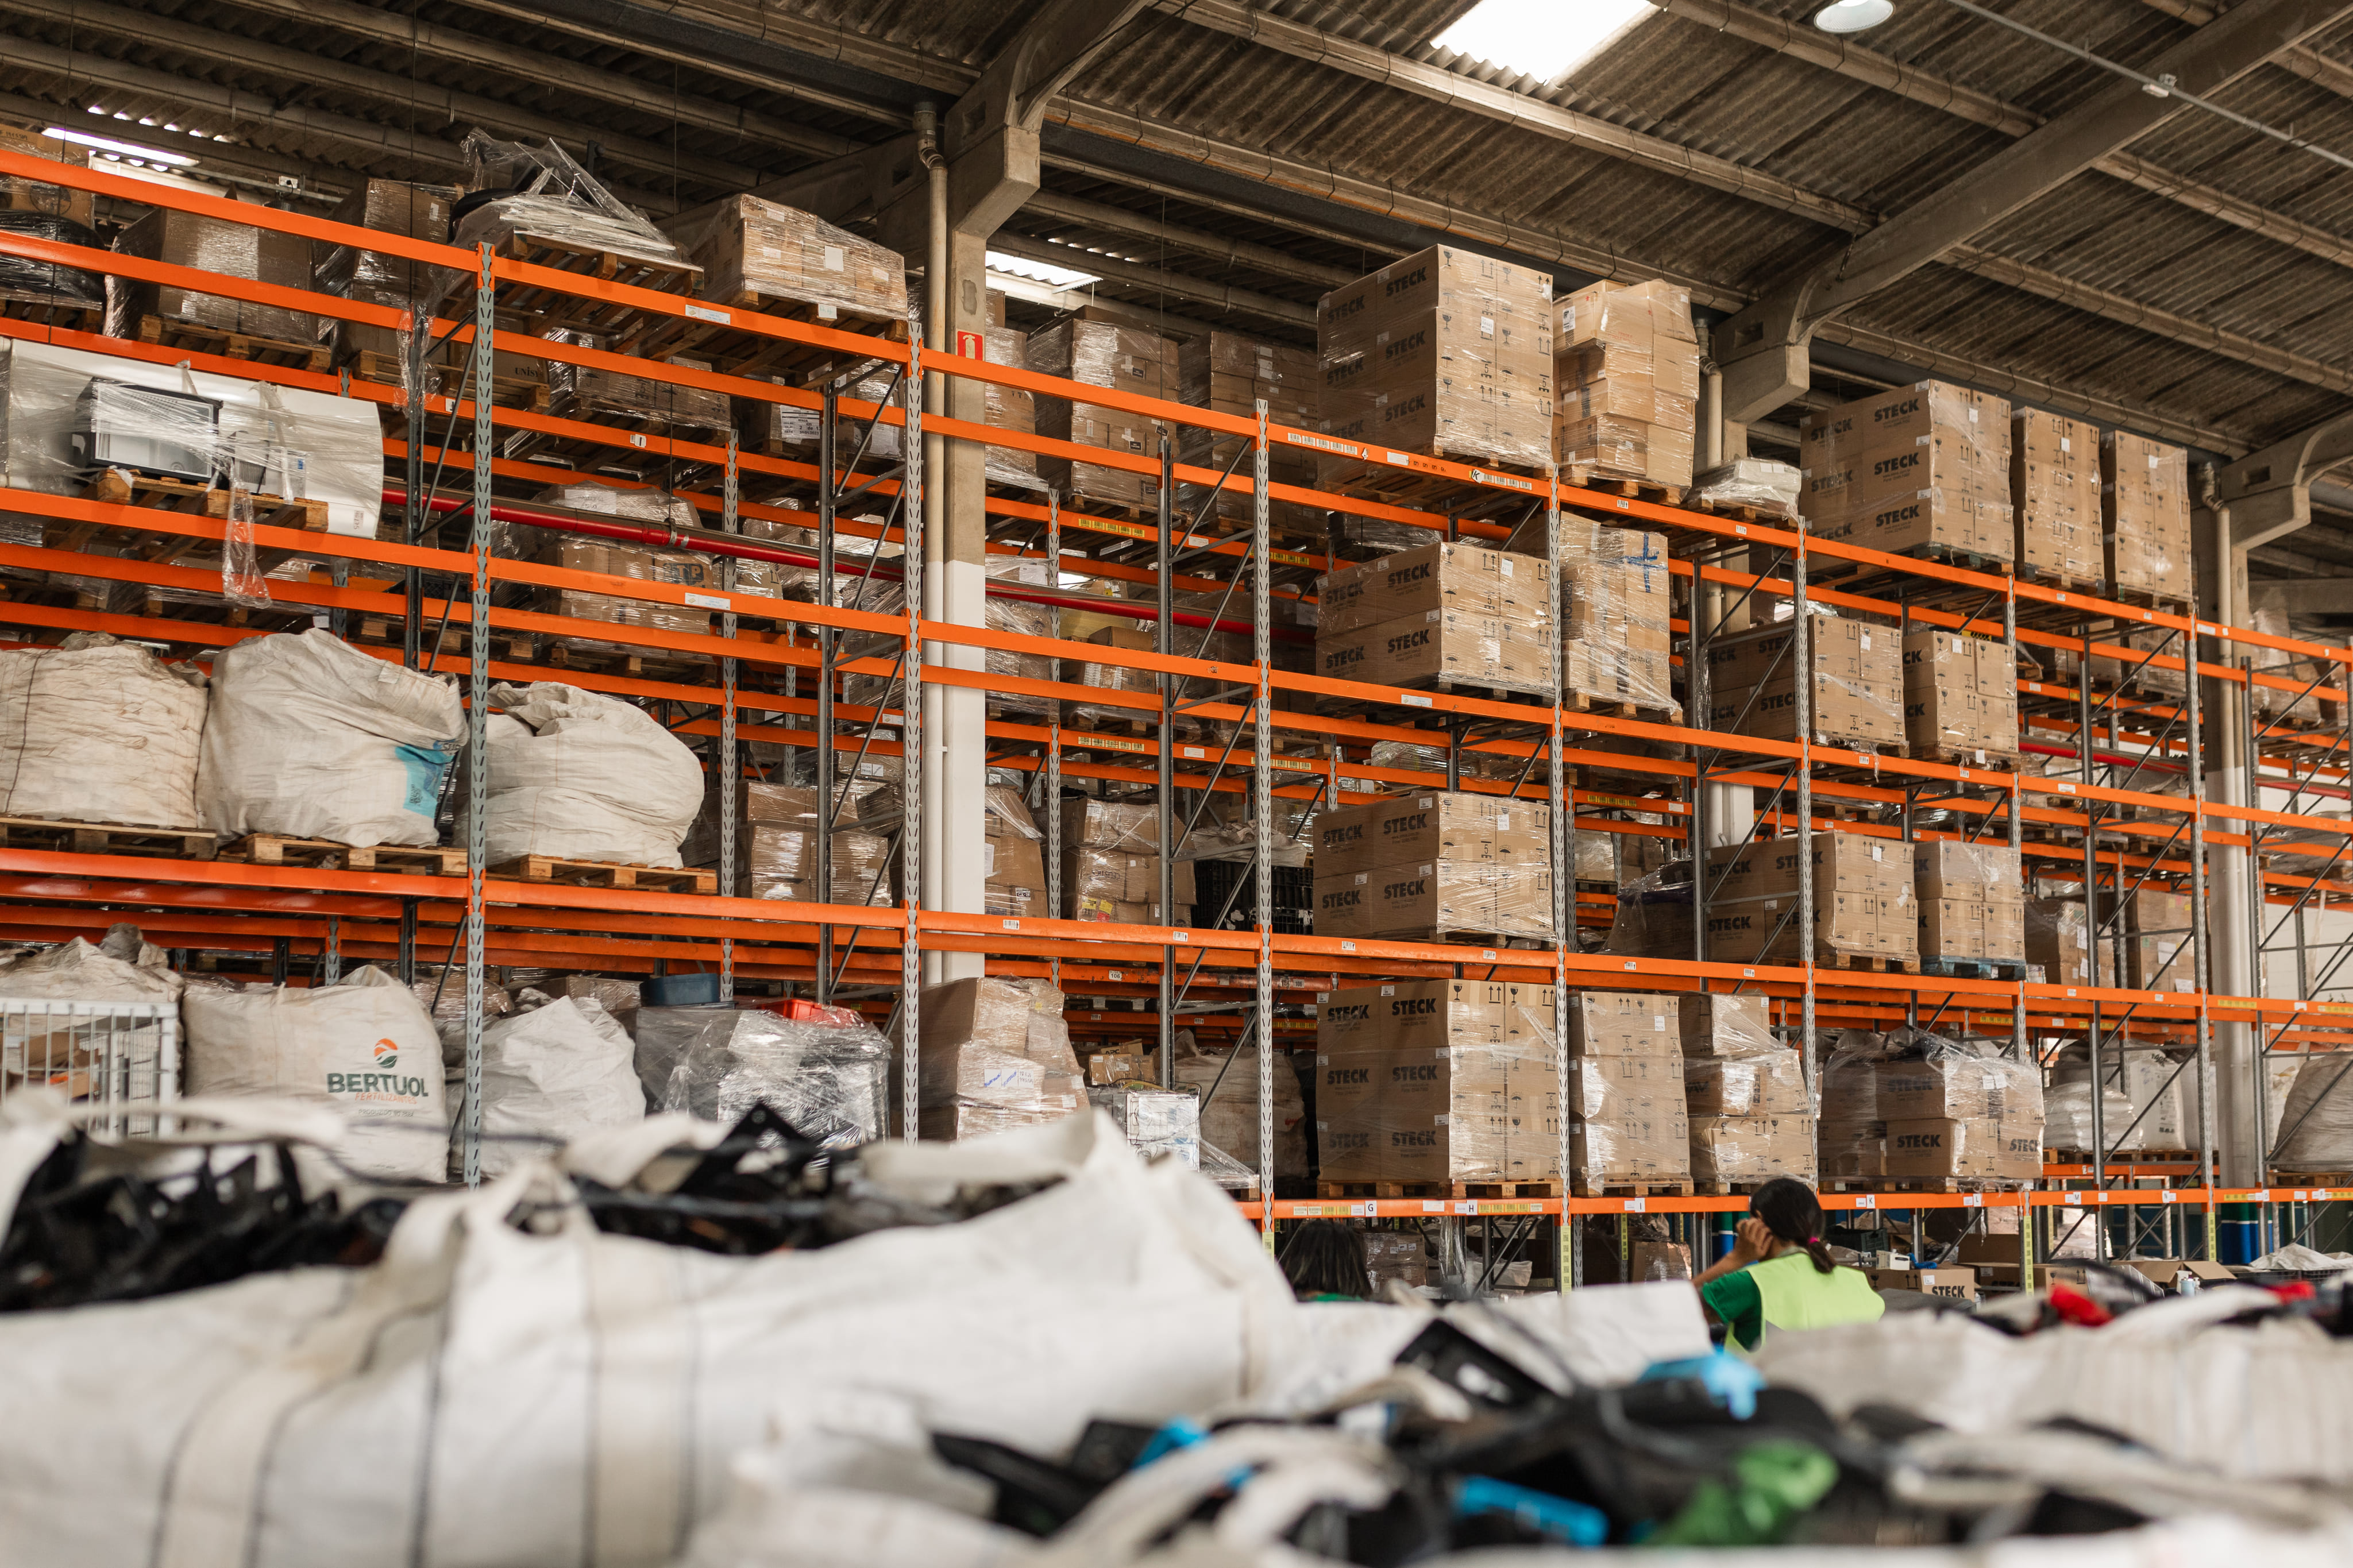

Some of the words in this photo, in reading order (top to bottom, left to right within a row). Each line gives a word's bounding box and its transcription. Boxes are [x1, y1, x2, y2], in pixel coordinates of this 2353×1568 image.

[1386, 267, 1427, 296] STECK
[1328, 295, 1365, 324] STECK
[1386, 331, 1425, 358] STECK
[1327, 357, 1364, 385] STECK
[1386, 395, 1425, 422] STECK
[1874, 399, 1919, 422] STECK
[1811, 418, 1852, 442] STCK
[1874, 453, 1919, 475] STECK
[1473, 470, 1480, 480] K
[1876, 504, 1920, 527] STECK
[1387, 562, 1430, 588] STECK
[1326, 581, 1364, 605] STECK
[1563, 580, 1573, 624] EPSON
[1387, 629, 1430, 653] STECK
[1326, 646, 1365, 669] STECK
[1710, 647, 1736, 665] ECK
[1711, 704, 1736, 720] ECK
[1383, 813, 1428, 835] STECK
[1323, 825, 1363, 845] STECK
[1776, 851, 1823, 870] STEK
[1384, 880, 1425, 899] STECK
[1322, 890, 1361, 909] STECK
[1708, 916, 1751, 932] STECK
[1328, 1004, 1370, 1022] STECK
[1392, 998, 1436, 1015] STECK
[1327, 1069, 1370, 1085] STECK
[1392, 1065, 1438, 1082] STECK
[327, 1073, 429, 1097] BERTUOL
[355, 1092, 417, 1104] FERTILIZANTES
[1328, 1133, 1370, 1149] STECK
[1392, 1130, 1437, 1146] STECK
[1897, 1135, 1941, 1148] STECK
[1368, 1204, 1374, 1212] G
[1932, 1285, 1965, 1297] STECK
